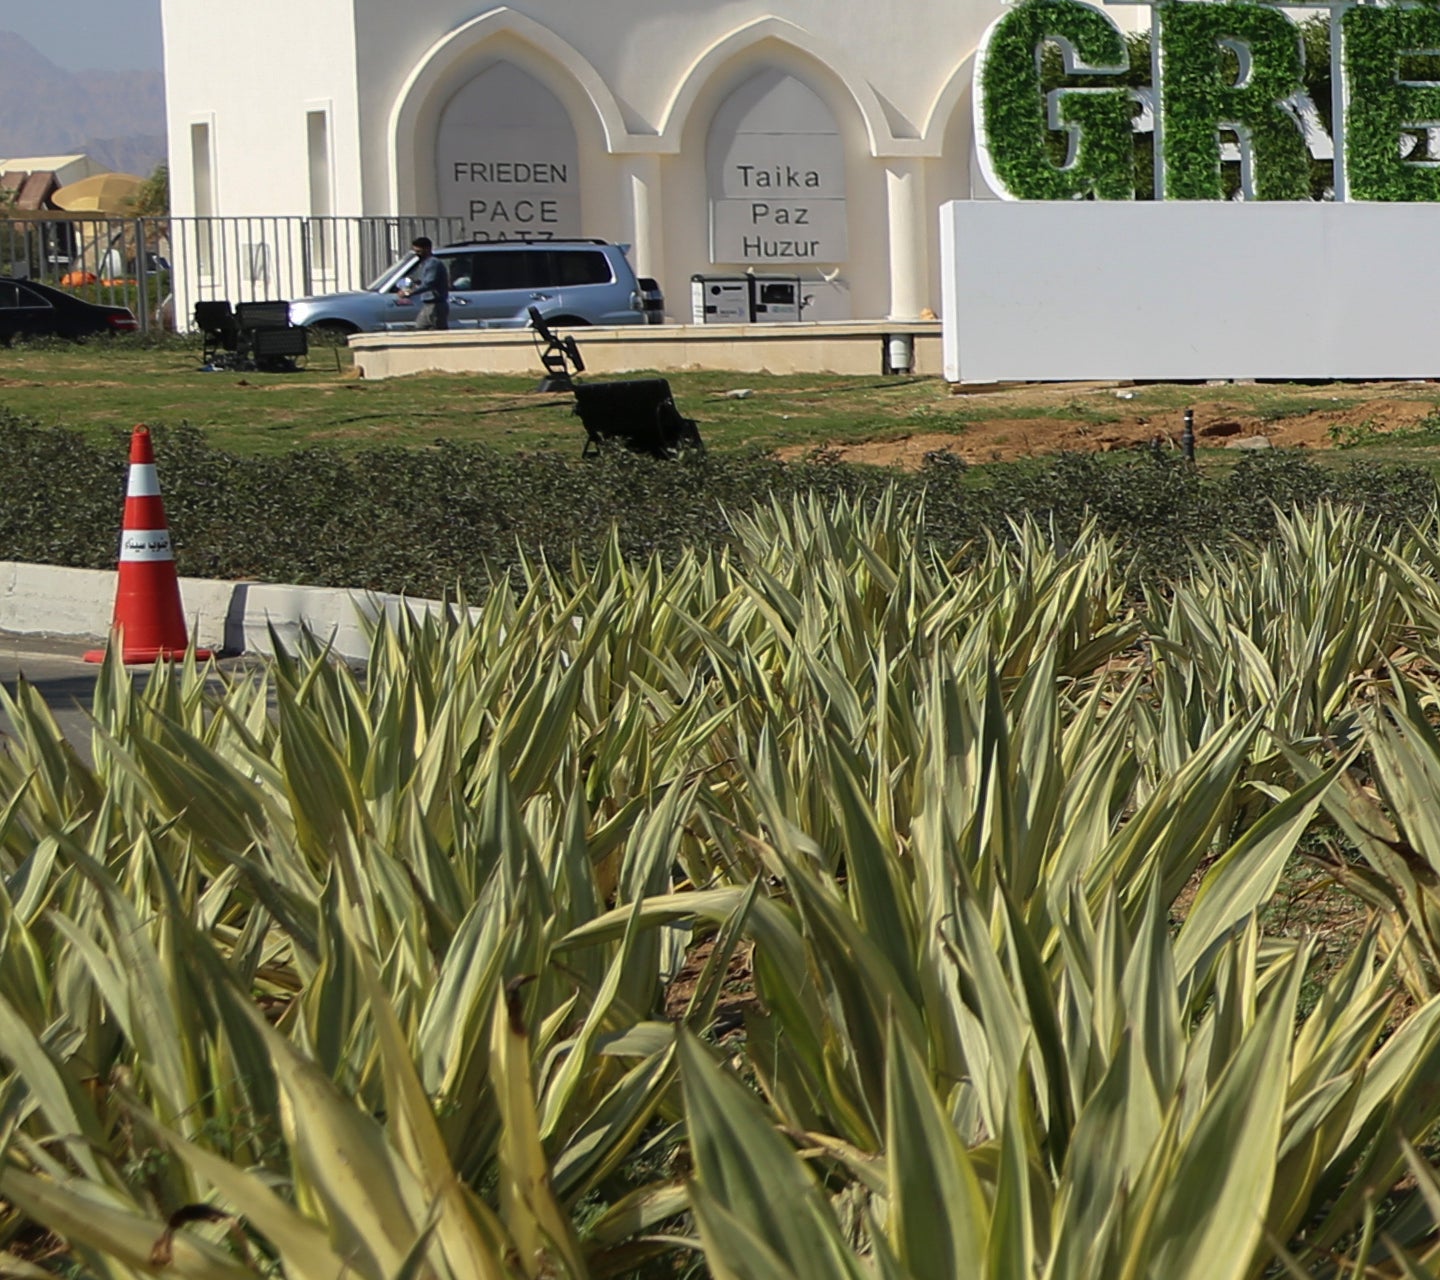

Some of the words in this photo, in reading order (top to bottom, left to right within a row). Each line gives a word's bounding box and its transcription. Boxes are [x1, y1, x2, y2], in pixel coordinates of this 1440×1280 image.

[454, 162, 567, 183] FRIEDEN
[736, 165, 820, 188] Taika
[469, 200, 558, 222] PACE
[752, 203, 809, 224] Paz
[743, 236, 819, 257] Huzur
